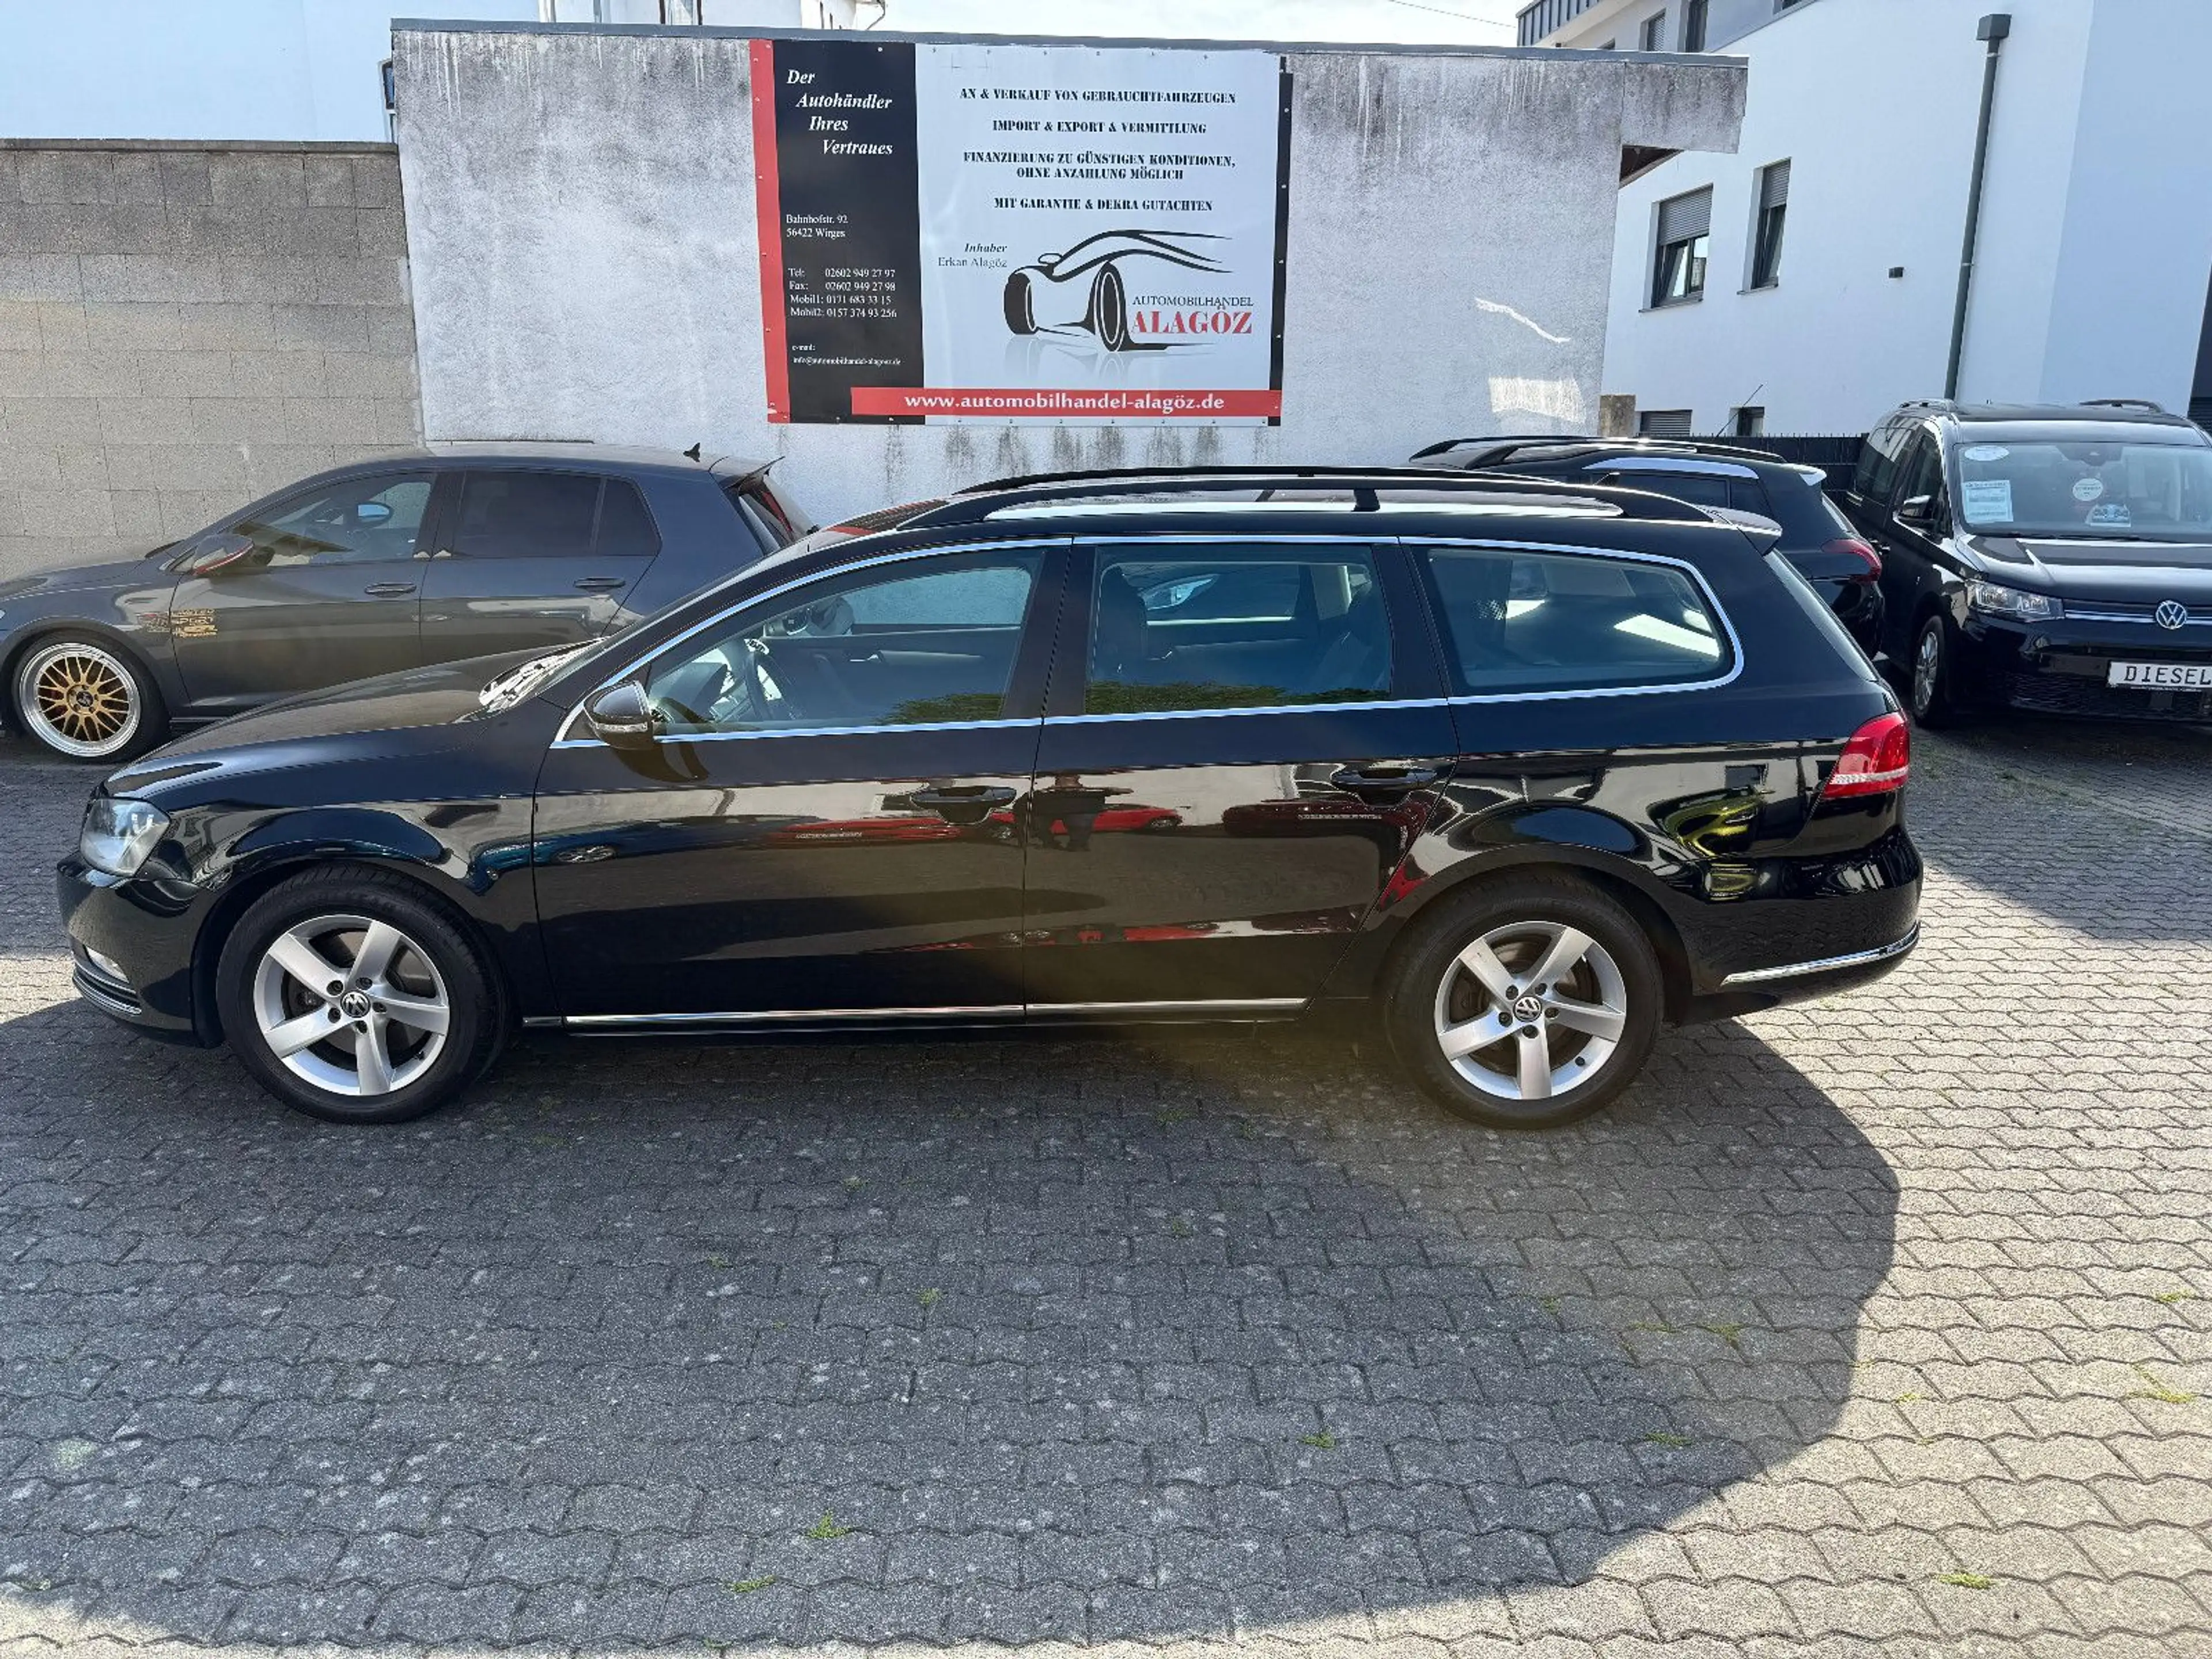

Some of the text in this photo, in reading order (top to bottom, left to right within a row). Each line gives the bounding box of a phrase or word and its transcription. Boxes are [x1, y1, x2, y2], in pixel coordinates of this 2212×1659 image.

[786, 69, 816, 85] Der
[796, 93, 892, 109] Autohändler
[960, 88, 1236, 104] AN & VERKAUF VON GEBRAUCHTFAHRZEUGEN
[809, 116, 849, 131] Ihres
[993, 120, 1207, 134] IMPORT & EXPORT & VERMITTLUNG
[822, 139, 893, 155] Vertraues
[964, 150, 1236, 168] FINANZIERUNG ZU GÜNSTIGEN KONDITIONEN,
[1017, 166, 1183, 180] OHNE ANZAHLUNG MÖGLICH
[994, 198, 1213, 211] MIT GARANTIE & DEKRA GUTACHTEN
[786, 214, 849, 224] Bahnhofstr. 92
[786, 228, 846, 240] 56422 Wirges
[964, 243, 1007, 253] Inhaber
[938, 257, 1007, 269] Erkan Alagöz
[825, 268, 851, 278] 02602
[853, 268, 869, 278] 949
[872, 269, 882, 278] 27
[885, 269, 896, 278] 97
[789, 281, 896, 291] Fax: 02602 949 27 98
[790, 294, 824, 304] Mobil1:
[881, 296, 892, 305] 15
[1132, 296, 1254, 306] AUTOMOBILHANDEL
[827, 308, 848, 317] 0157
[850, 308, 865, 317] 374
[868, 308, 879, 318] 93
[881, 309, 897, 317] 256
[1131, 305, 1252, 334] ALAGÖZ
[904, 392, 1225, 414] www.automobilhandel-alagöz.de
[2155, 600, 2188, 630] VW
[2123, 665, 2211, 685] DIESEL
